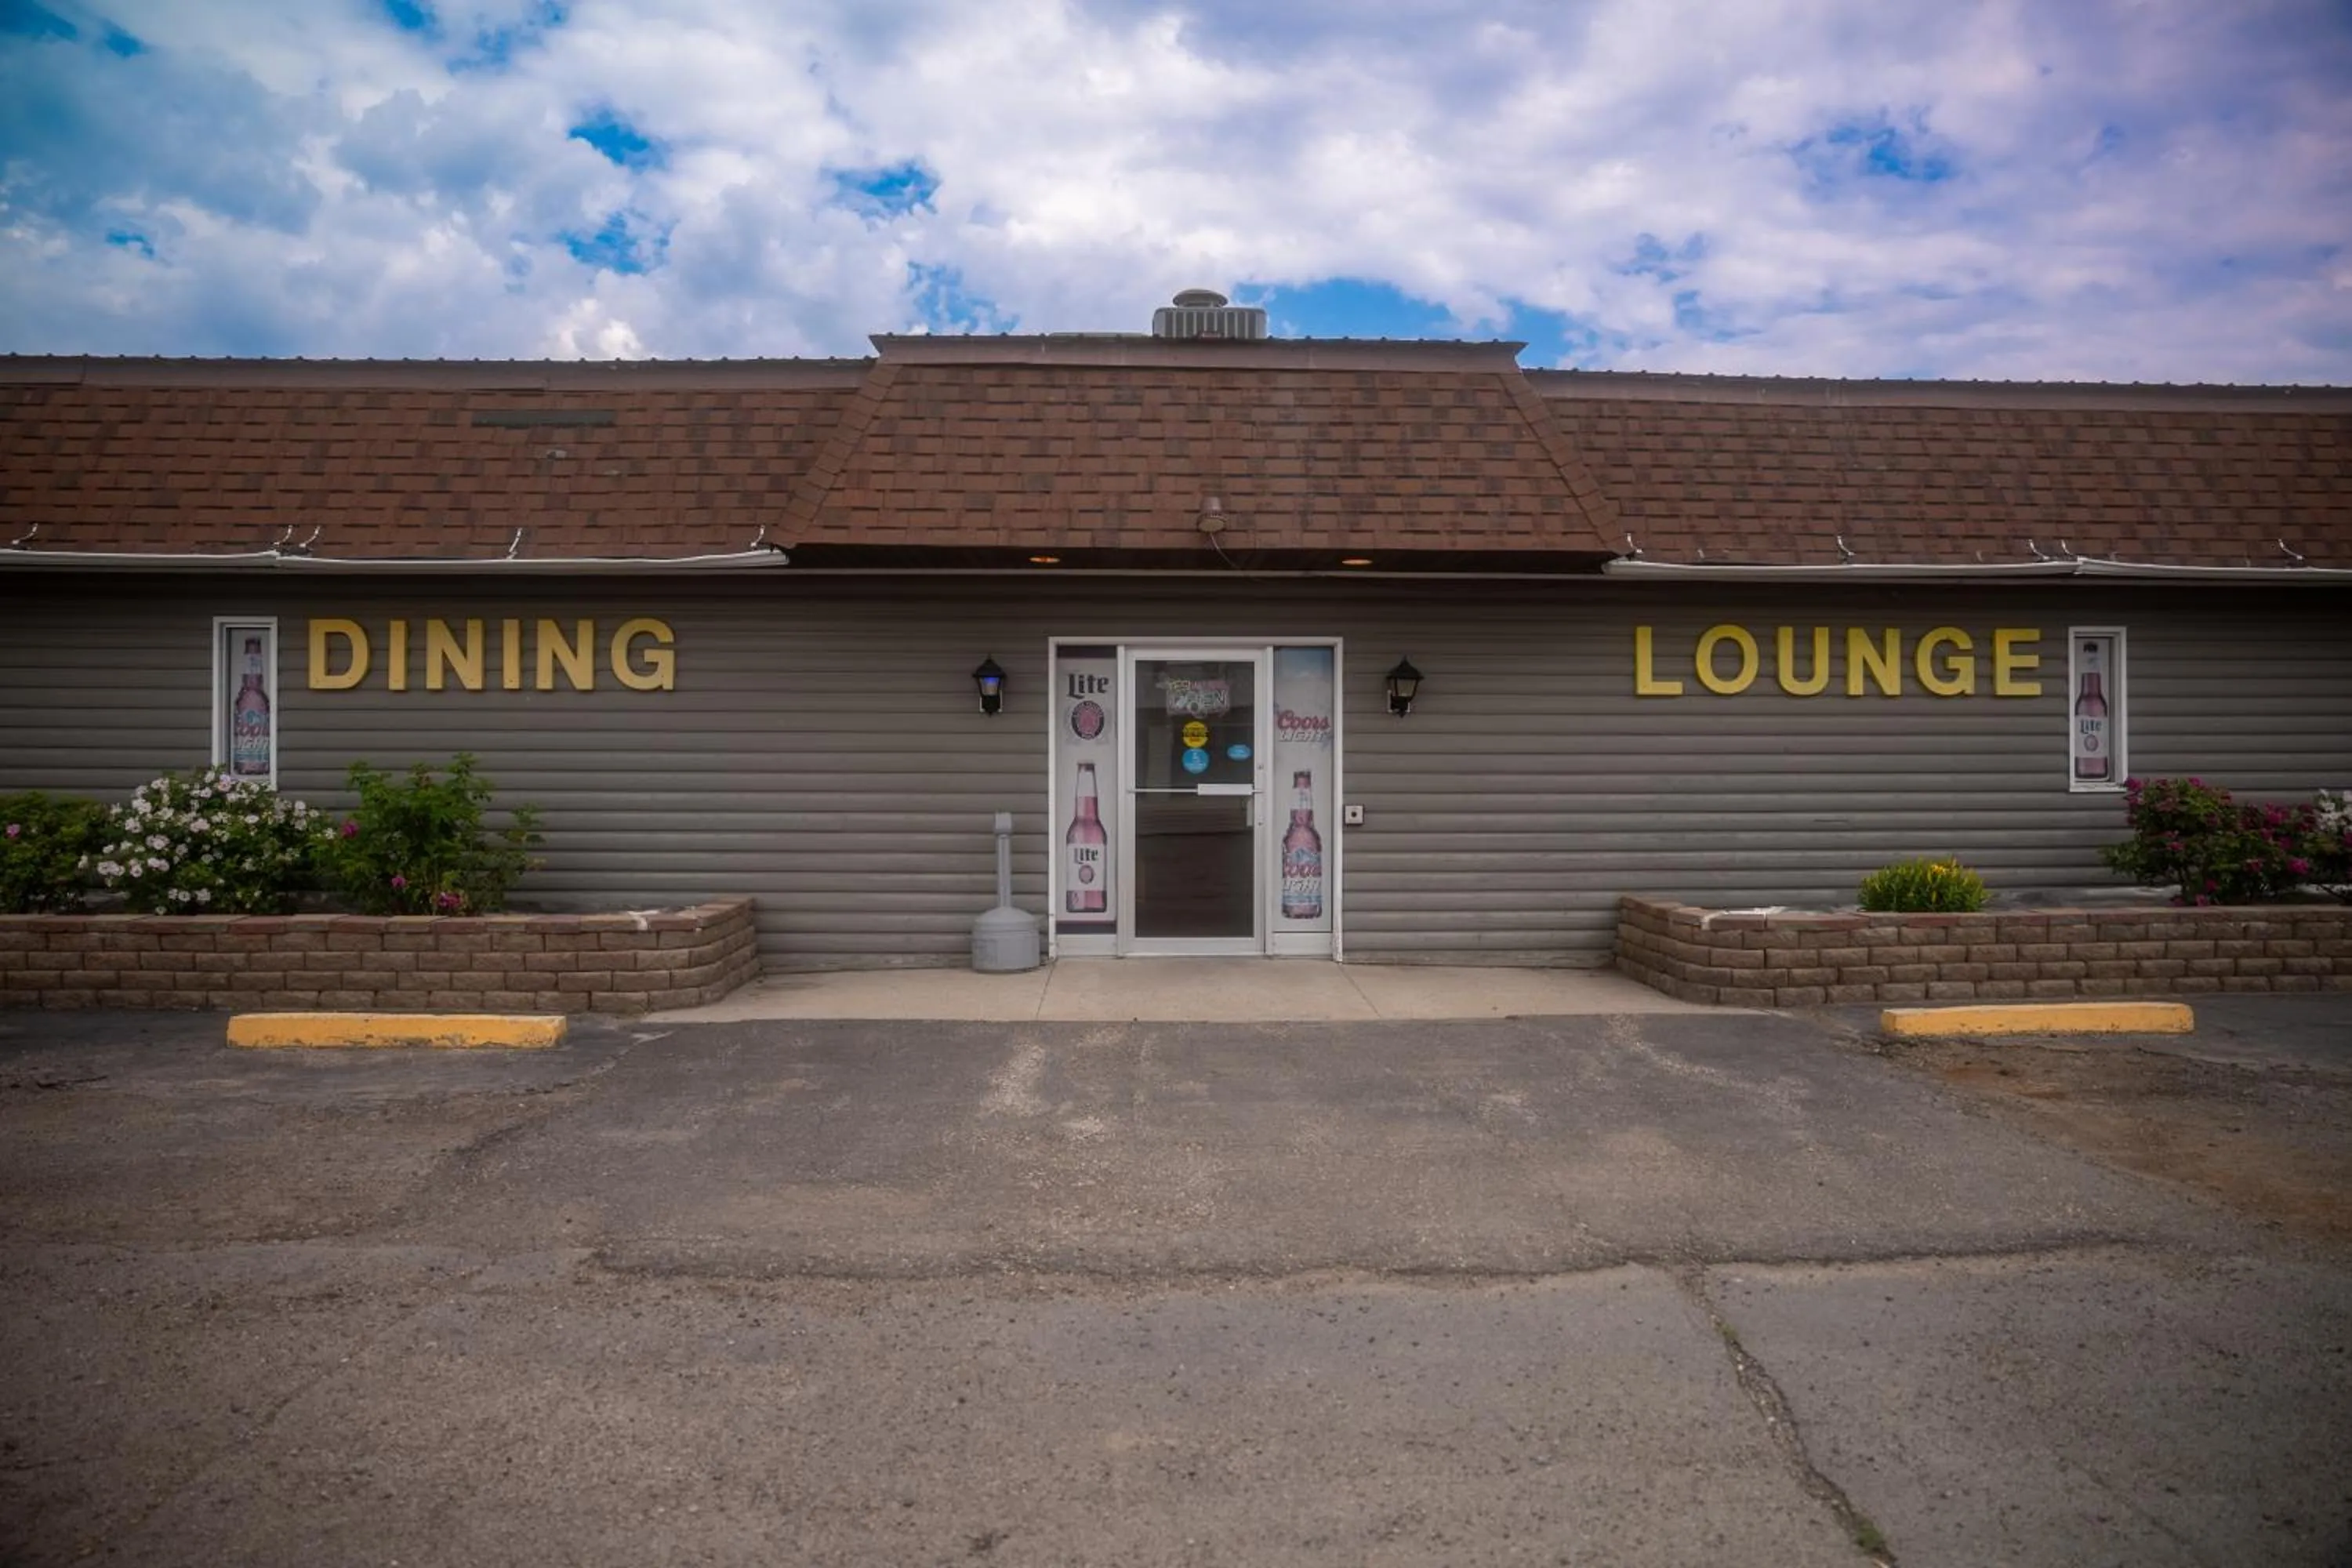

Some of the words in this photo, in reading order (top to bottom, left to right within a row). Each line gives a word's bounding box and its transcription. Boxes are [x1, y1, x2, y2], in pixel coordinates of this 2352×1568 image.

[308, 619, 676, 690] DINING
[1635, 625, 2043, 695] LOUNGE
[1067, 673, 1109, 699] Lite
[1278, 710, 1331, 730] Coors
[1073, 848, 1098, 865] Lite
